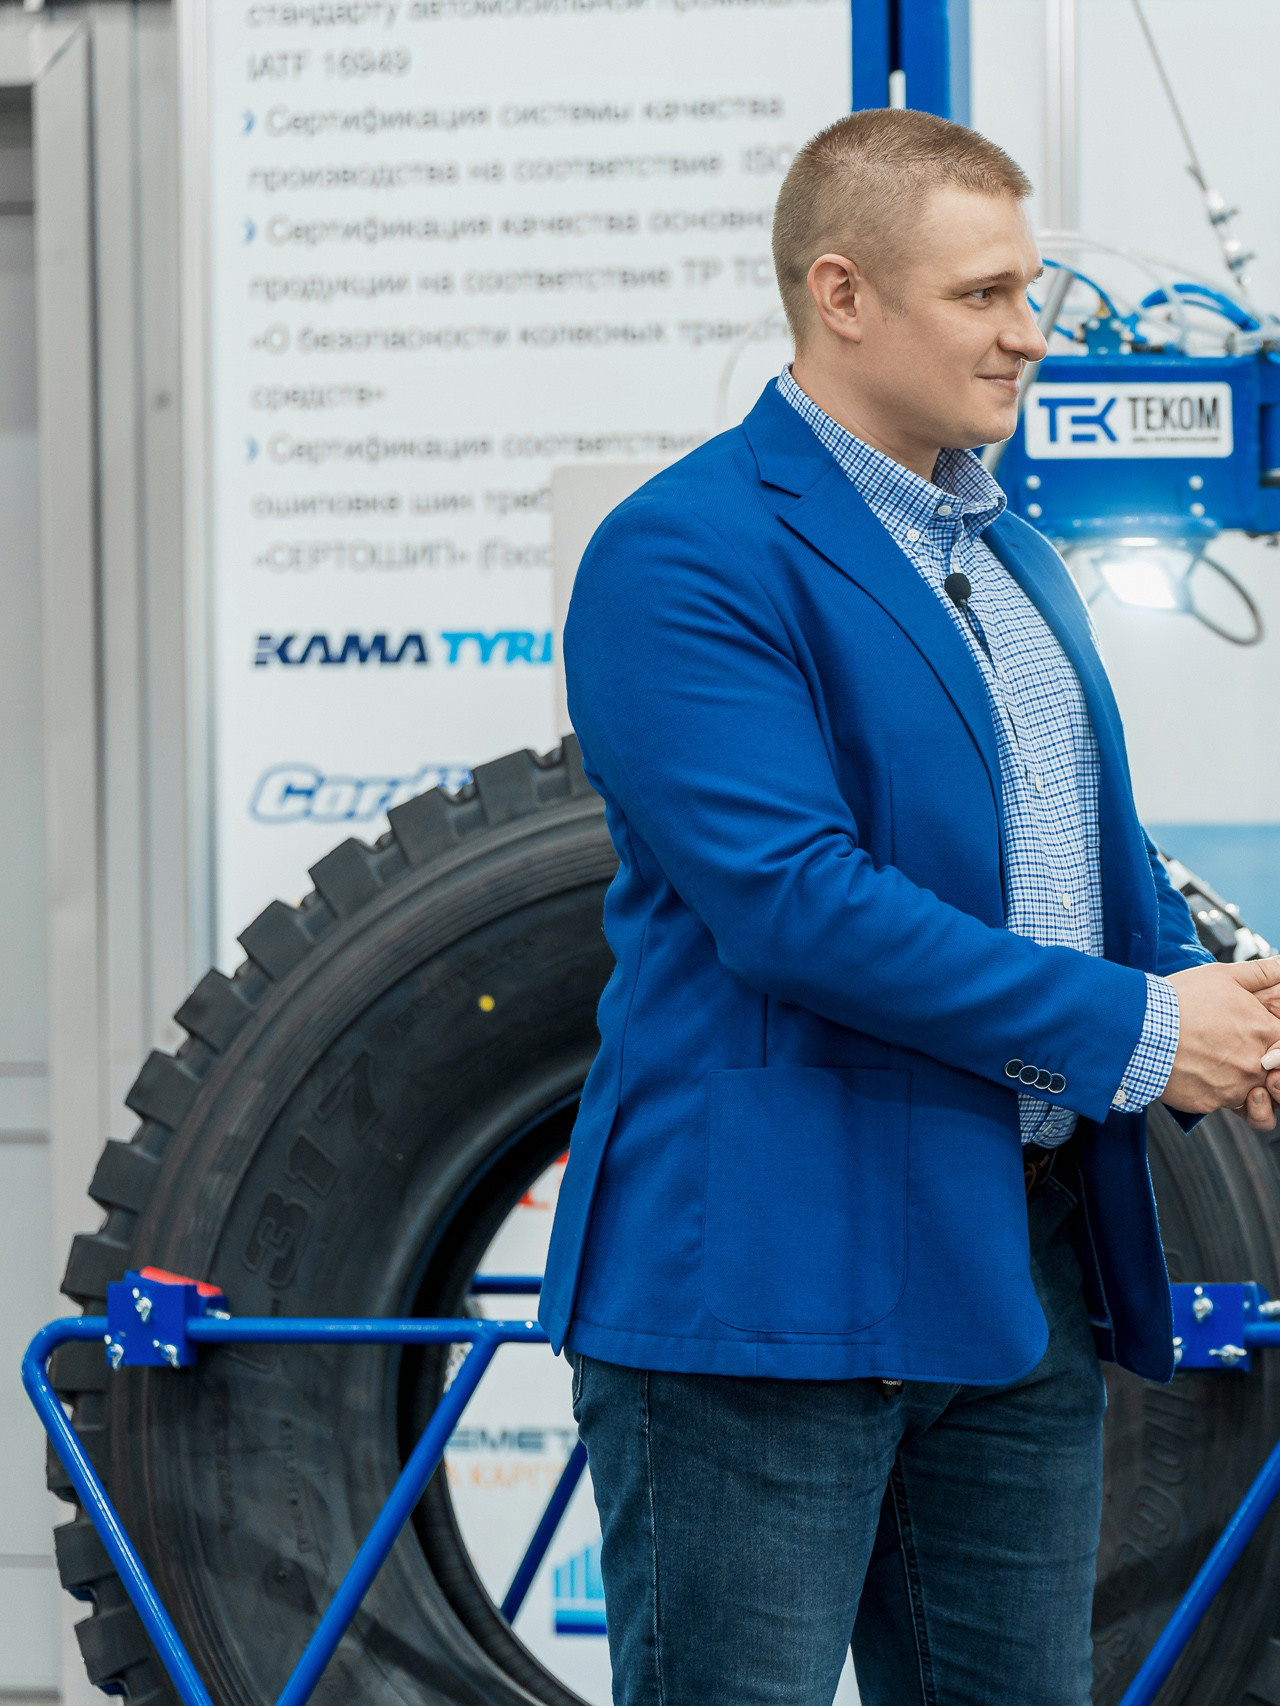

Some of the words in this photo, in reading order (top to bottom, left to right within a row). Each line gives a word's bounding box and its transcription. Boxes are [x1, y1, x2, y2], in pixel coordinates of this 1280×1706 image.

[324, 48, 412, 79] 16949
[266, 106, 491, 138] Сертификация
[500, 102, 633, 127] системы
[641, 96, 784, 123] качества
[248, 162, 460, 194] производства
[267, 216, 492, 247] Сертификация
[499, 212, 641, 238] качества
[249, 274, 410, 303] продукции
[297, 325, 510, 353] безопасности
[1127, 396, 1221, 432] TEKOM
[269, 435, 494, 466] Сертификация
[254, 634, 429, 665] KAMA
